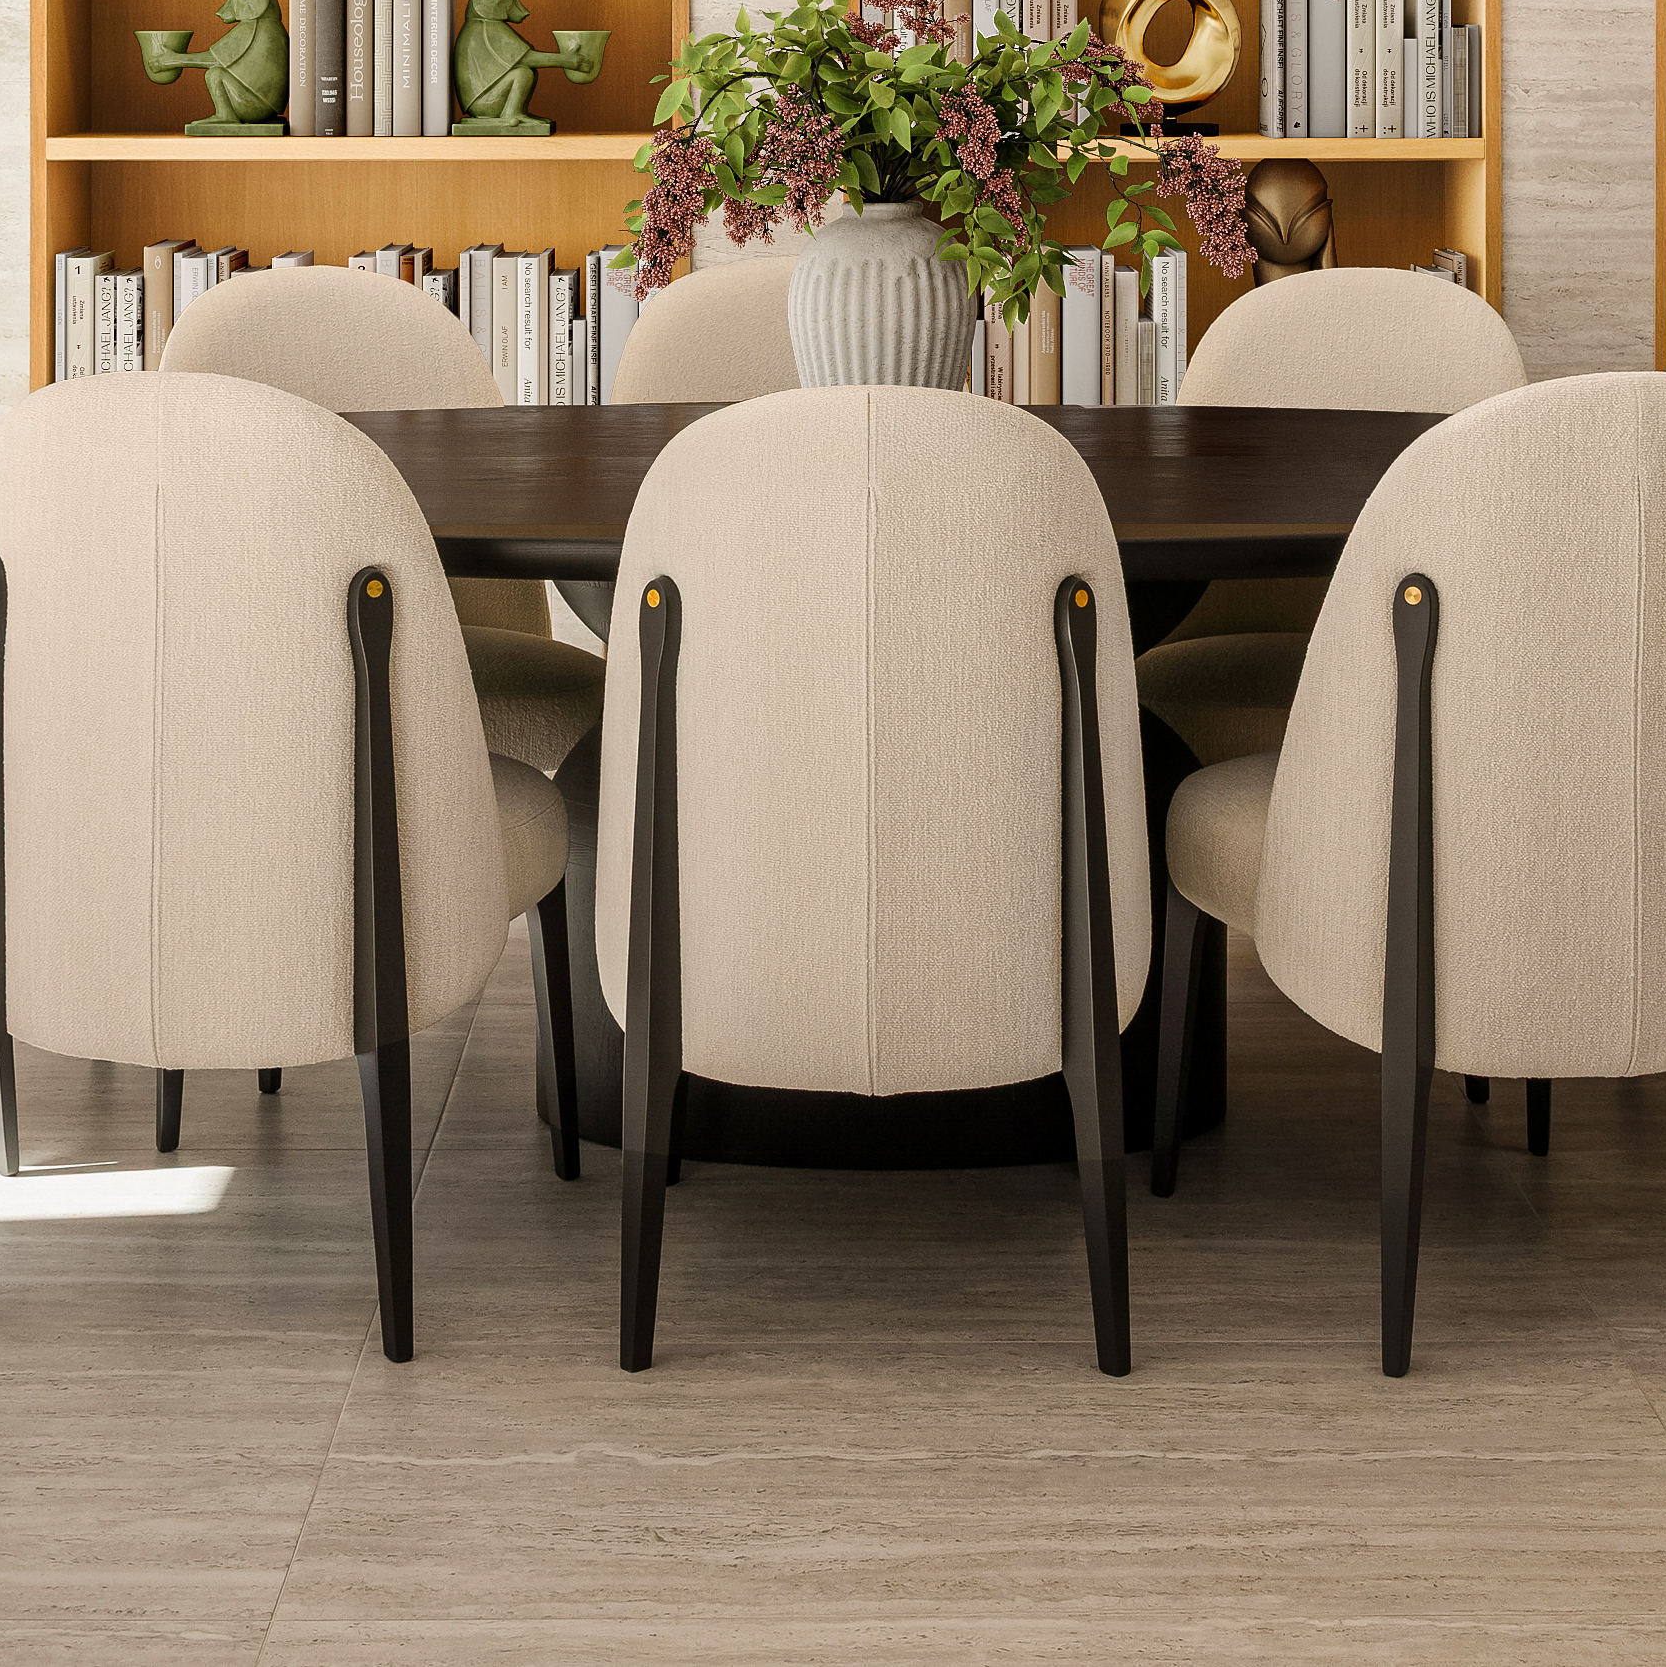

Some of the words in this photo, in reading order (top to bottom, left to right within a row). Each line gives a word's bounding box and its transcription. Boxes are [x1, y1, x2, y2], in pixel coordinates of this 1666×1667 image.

[430, 0, 438, 48] INTERIOR
[299, 17, 307, 87] DECORATION
[1426, 32, 1436, 88] MICHAEL
[430, 49, 438, 84] DECOR
[1426, 91, 1436, 102] IS
[1426, 105, 1436, 137] WHO
[524, 262, 533, 276] No
[1161, 261, 1170, 275] No
[524, 277, 533, 308] search
[1161, 276, 1170, 307] search
[524, 310, 533, 335] result
[1160, 308, 1170, 334] result
[524, 337, 533, 351] for
[1160, 335, 1170, 349] for
[523, 378, 533, 403] Anita
[1160, 376, 1170, 402] Anita
